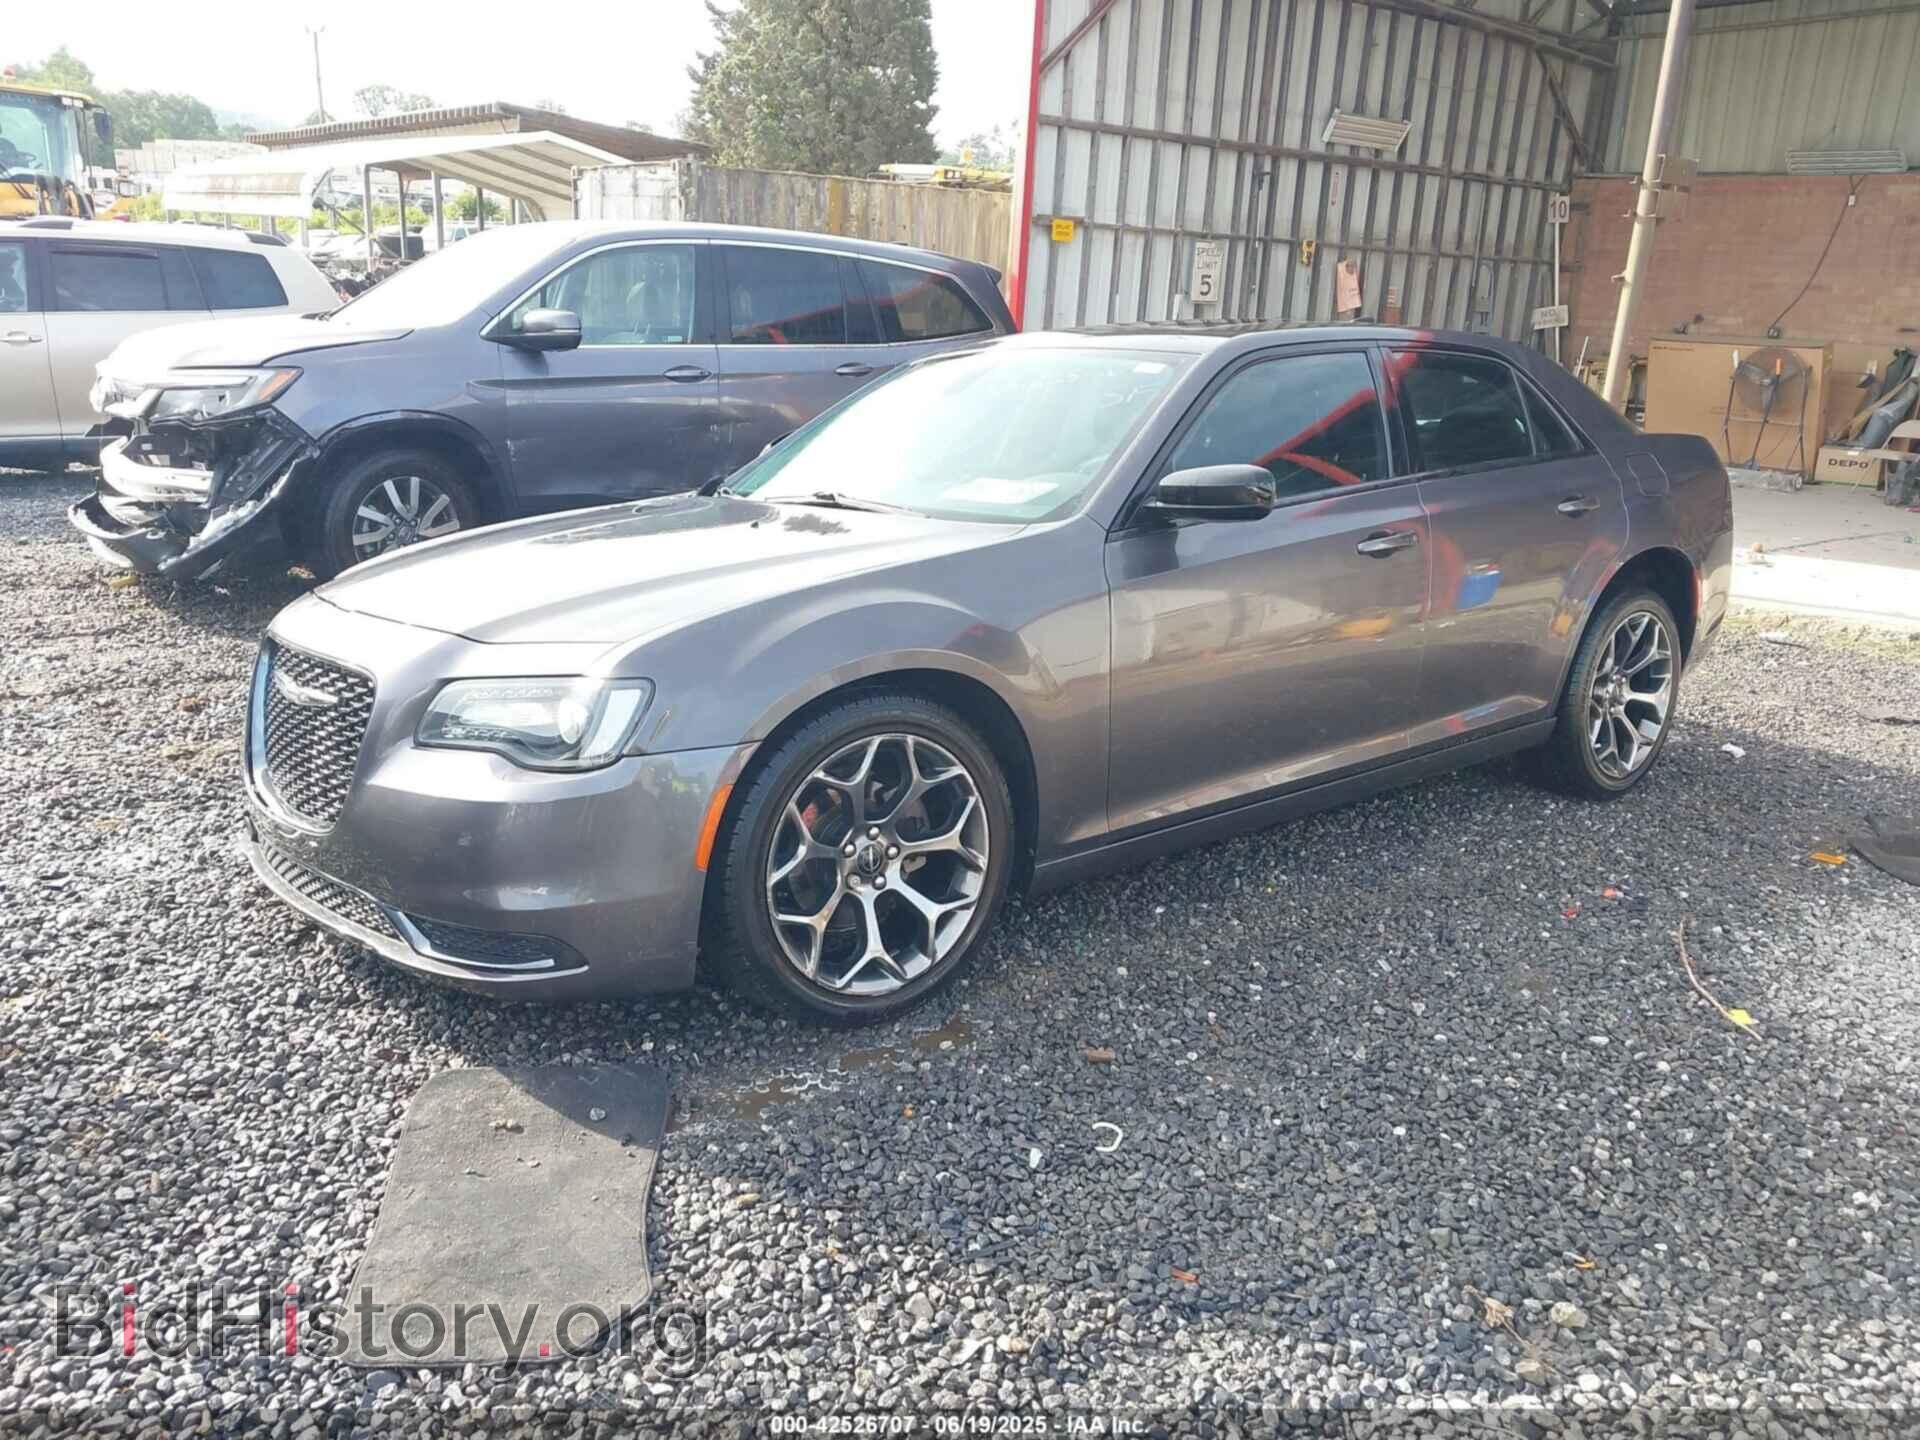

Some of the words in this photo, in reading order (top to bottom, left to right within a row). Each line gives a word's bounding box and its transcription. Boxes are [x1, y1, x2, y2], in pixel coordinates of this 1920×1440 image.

[1550, 200, 1567, 219] 10
[1200, 274, 1211, 296] 5
[1828, 458, 1868, 469] DEPO
